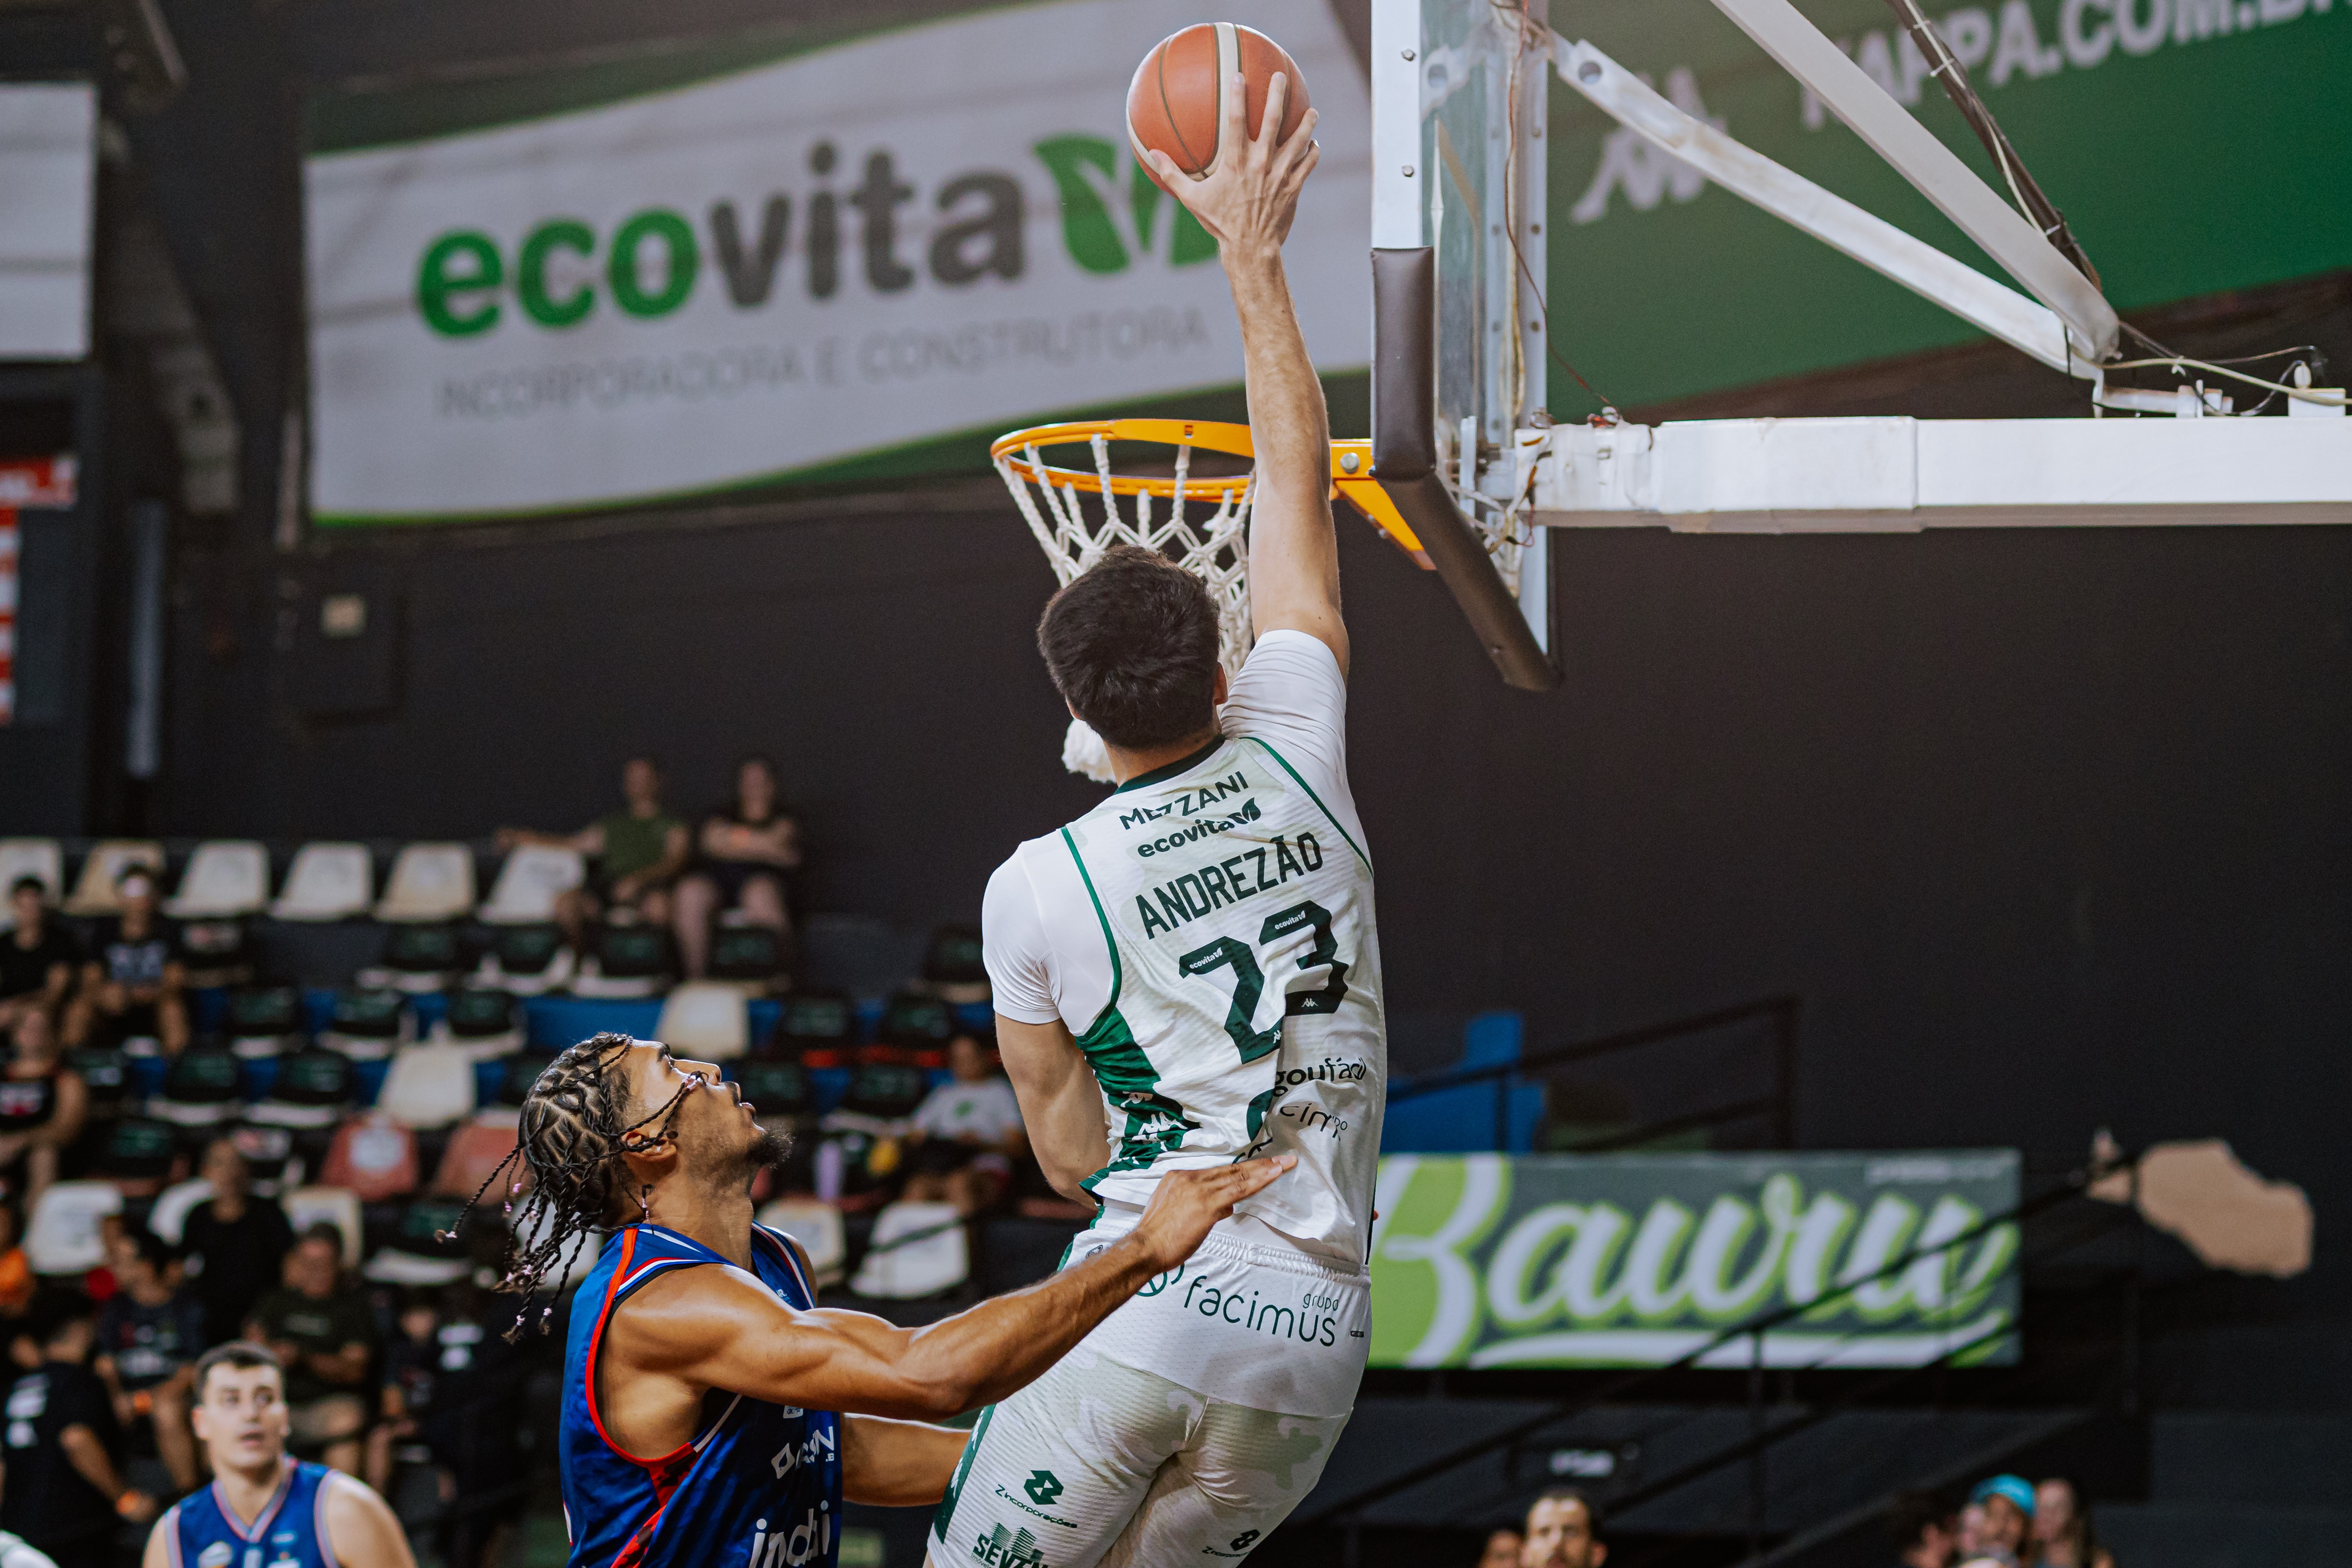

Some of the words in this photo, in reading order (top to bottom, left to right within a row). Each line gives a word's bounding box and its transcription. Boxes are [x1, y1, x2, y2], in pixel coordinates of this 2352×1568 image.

[416, 141, 1026, 338] ecovita
[1137, 818, 1235, 857] ecovita
[1135, 831, 1323, 940] ANDREZÃO
[1275, 916, 1299, 930] ecovita
[1179, 900, 1350, 1065] 23
[1189, 953, 1215, 969] ecovita
[1183, 1275, 1336, 1347] facimus
[1302, 1293, 1339, 1313] grupo
